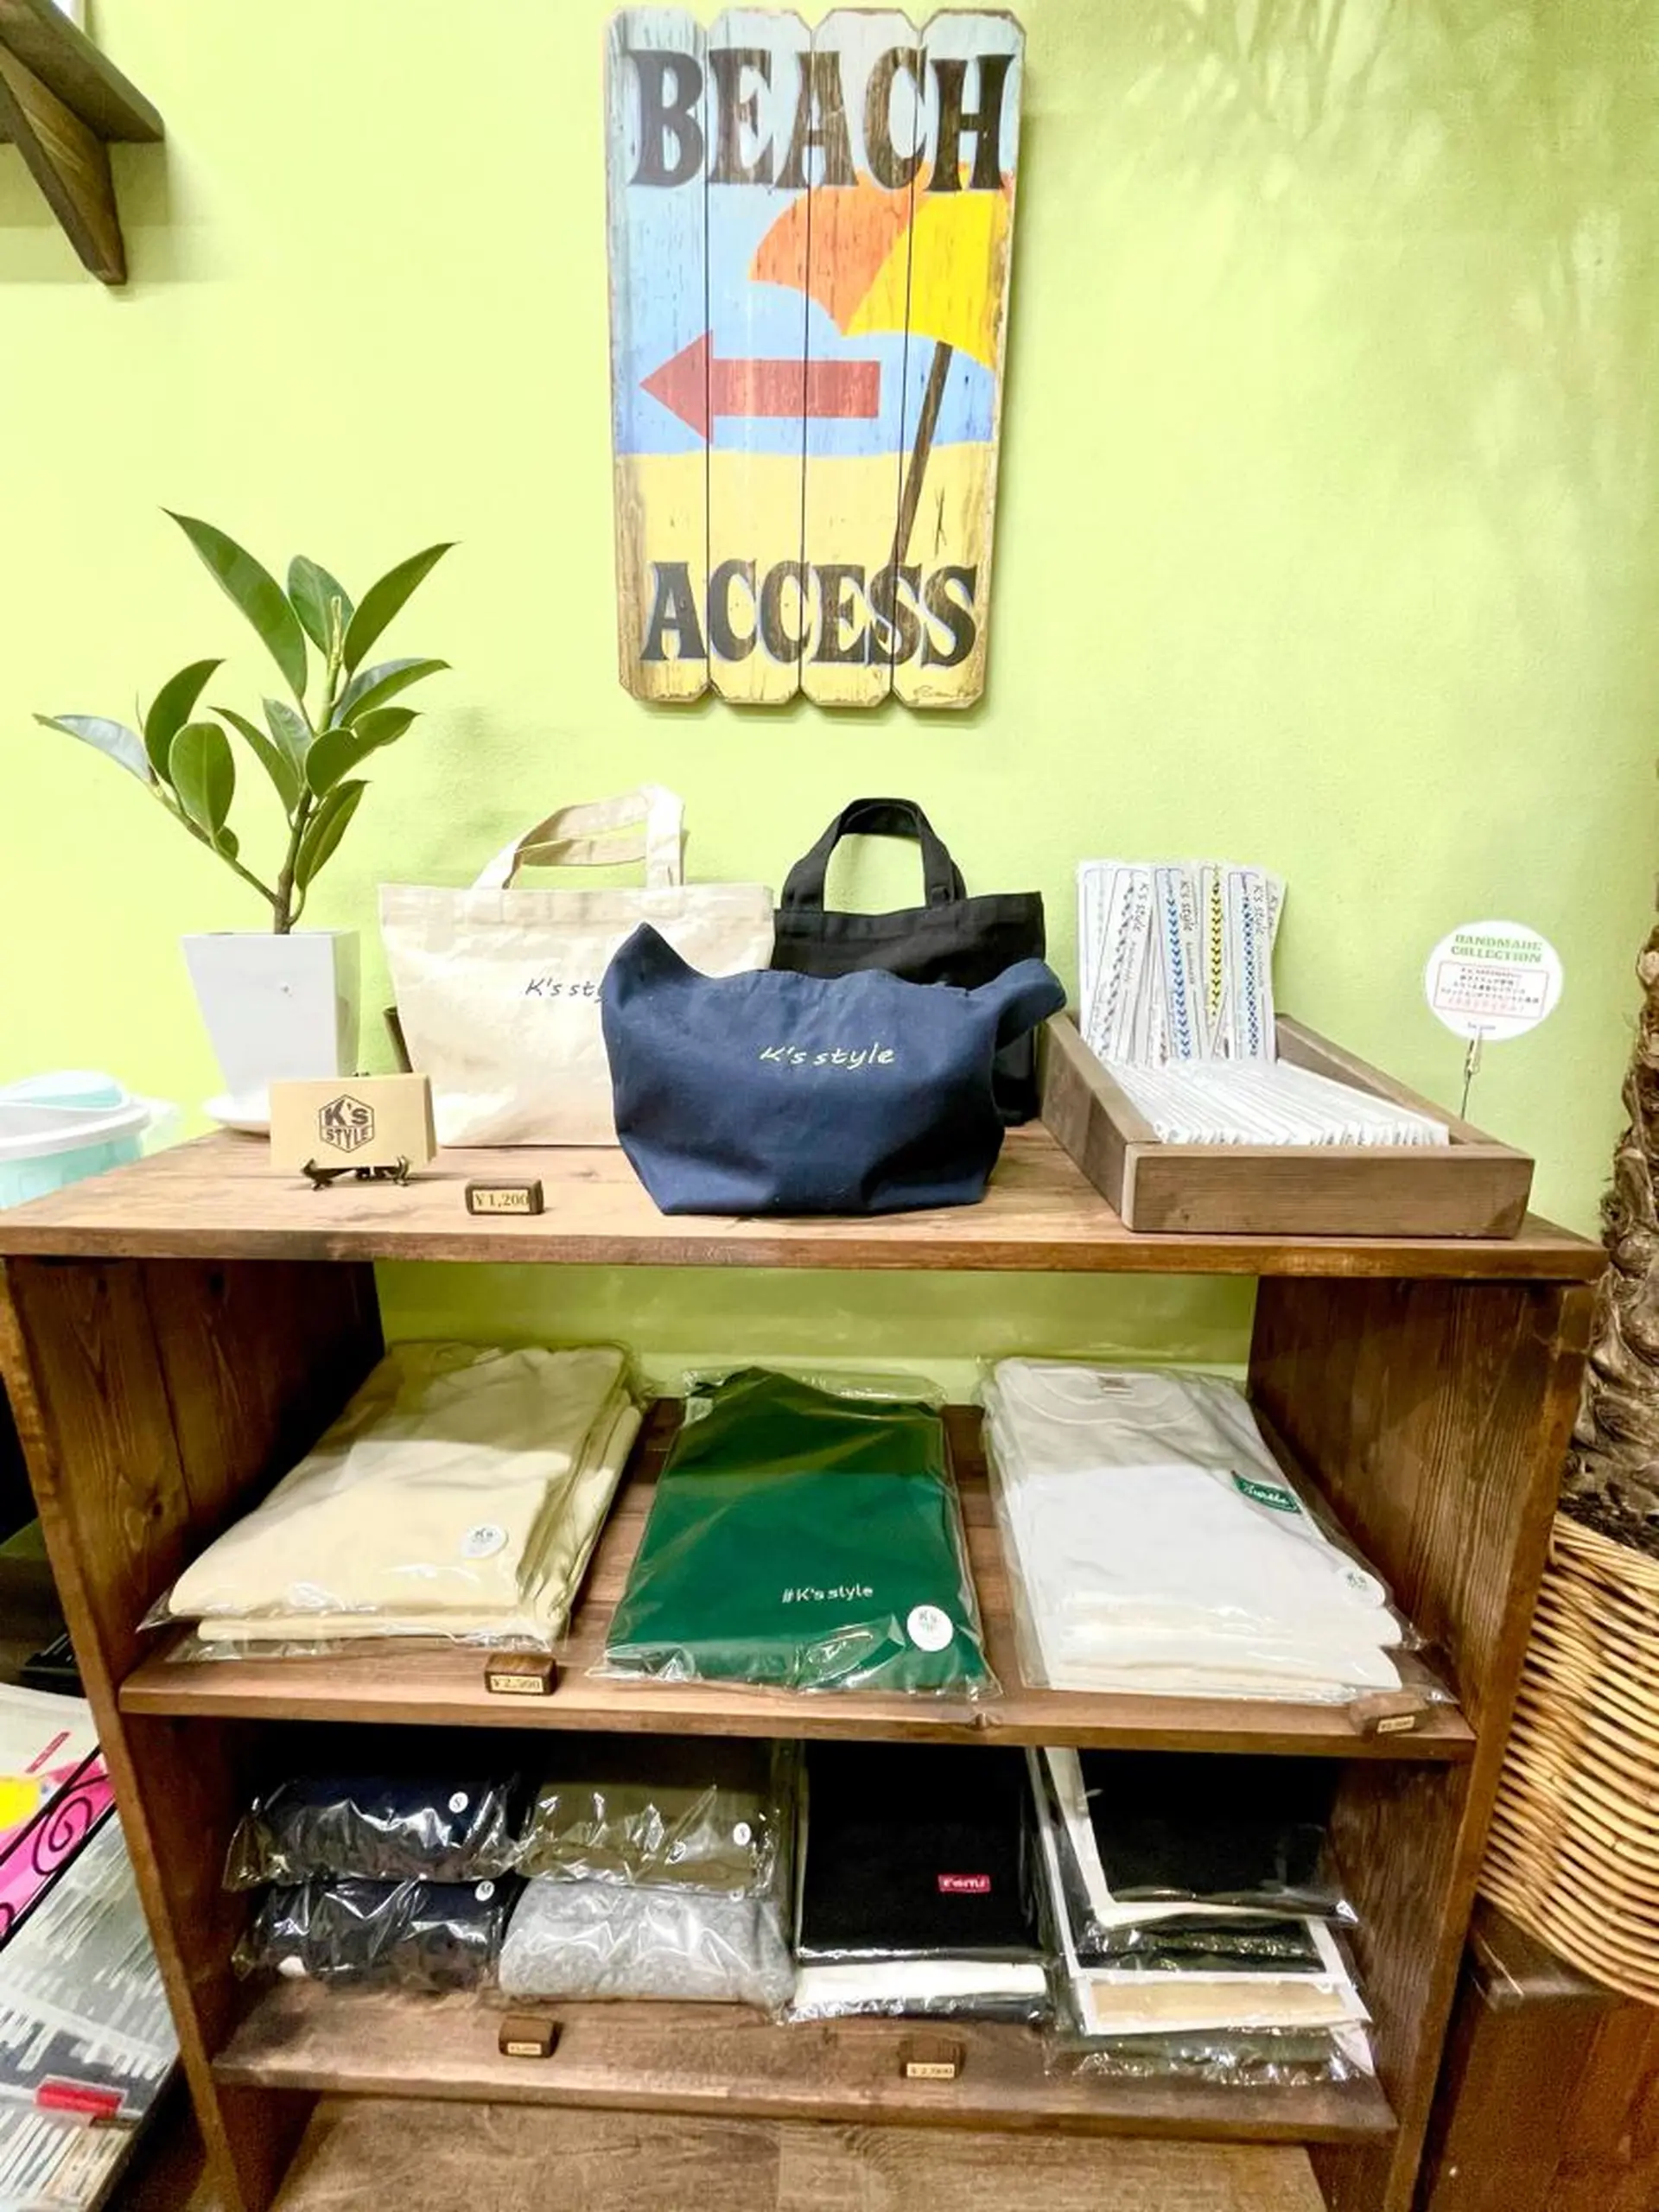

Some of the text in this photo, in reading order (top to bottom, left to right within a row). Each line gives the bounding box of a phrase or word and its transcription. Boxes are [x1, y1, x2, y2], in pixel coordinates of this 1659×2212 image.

[628, 46, 1016, 191] BEACH
[639, 557, 979, 668] ACCESS
[1455, 934, 1543, 951] HANDMADE
[1451, 945, 1542, 963] COLLECTION
[524, 977, 563, 996] K's
[759, 1042, 895, 1071] K's style
[325, 1098, 369, 1126] K's
[327, 1128, 368, 1149] STYLE
[827, 1583, 874, 1602] style
